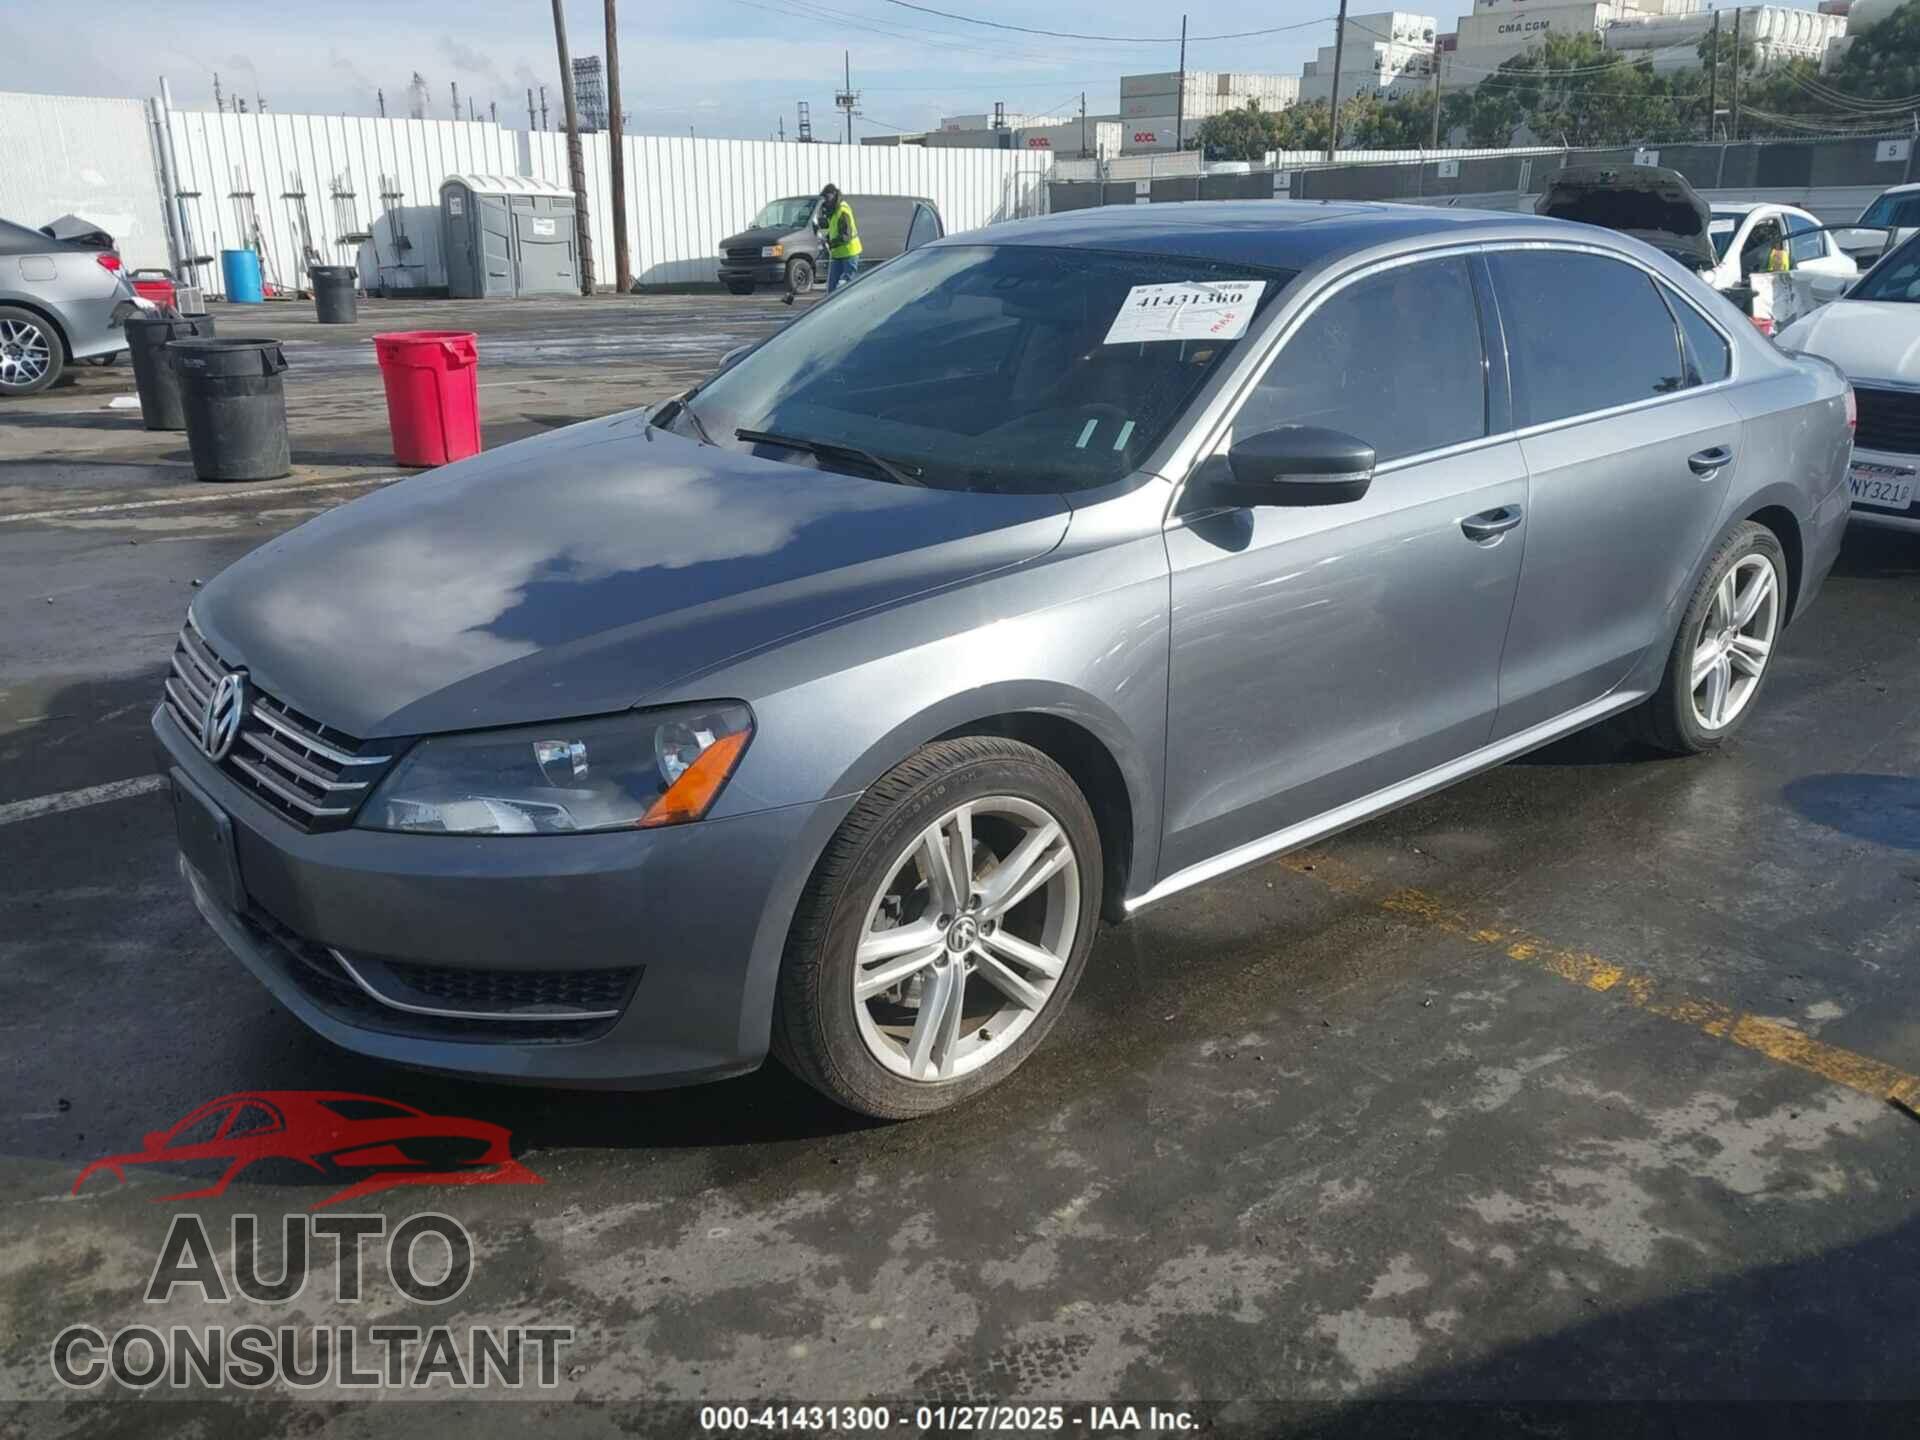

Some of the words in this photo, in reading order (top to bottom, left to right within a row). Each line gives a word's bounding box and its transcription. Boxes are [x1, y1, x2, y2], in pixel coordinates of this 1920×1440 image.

[1497, 24, 1522, 33] CMA
[1524, 20, 1550, 31] CGM
[1888, 144, 1897, 157] 5
